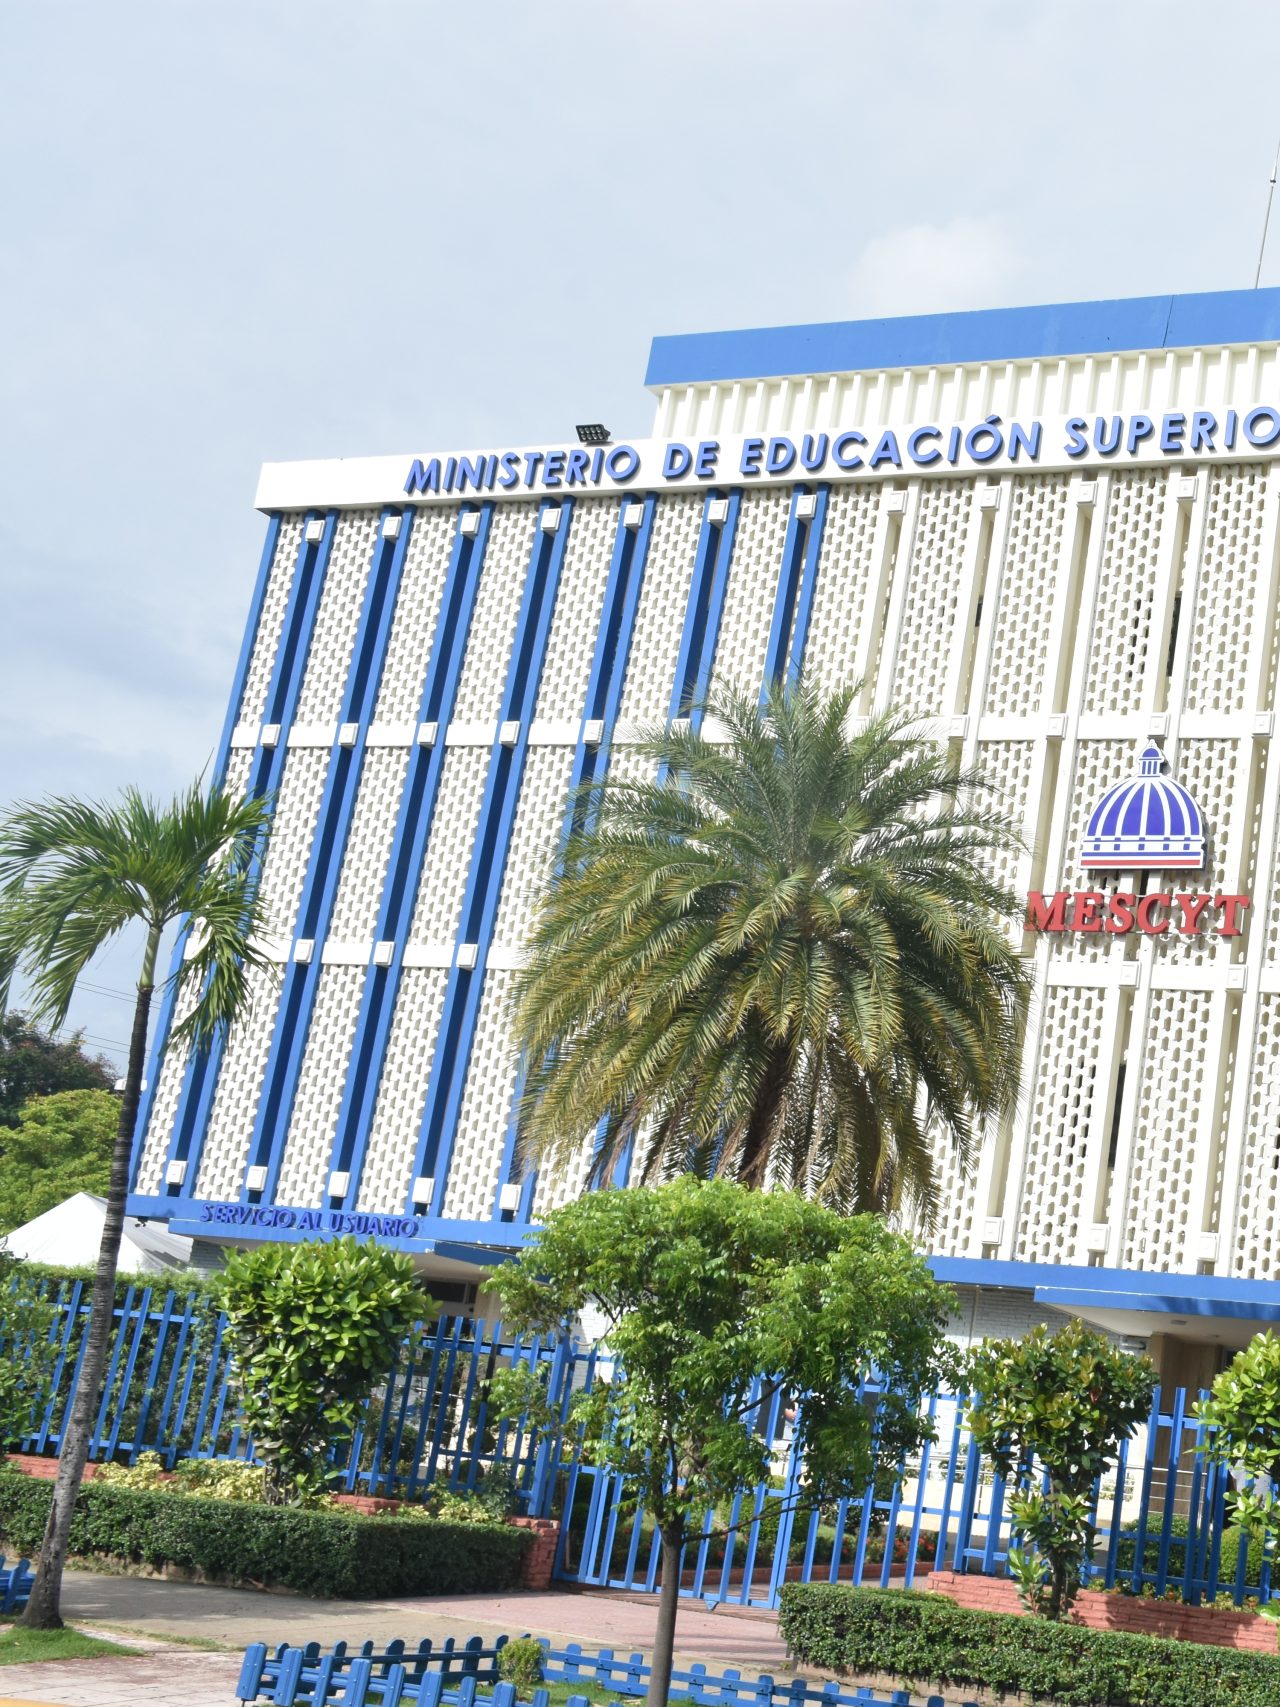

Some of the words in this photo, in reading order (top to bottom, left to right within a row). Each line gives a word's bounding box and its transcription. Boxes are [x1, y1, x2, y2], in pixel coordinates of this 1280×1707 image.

[403, 444, 640, 495] MINISTERIO
[662, 440, 719, 479] DE
[739, 415, 1042, 475] EDUCACIÓN
[1023, 890, 1249, 937] MESCYT
[200, 1203, 296, 1229] SERVICIO
[298, 1211, 324, 1231] AL
[329, 1214, 419, 1239] USUARIO
